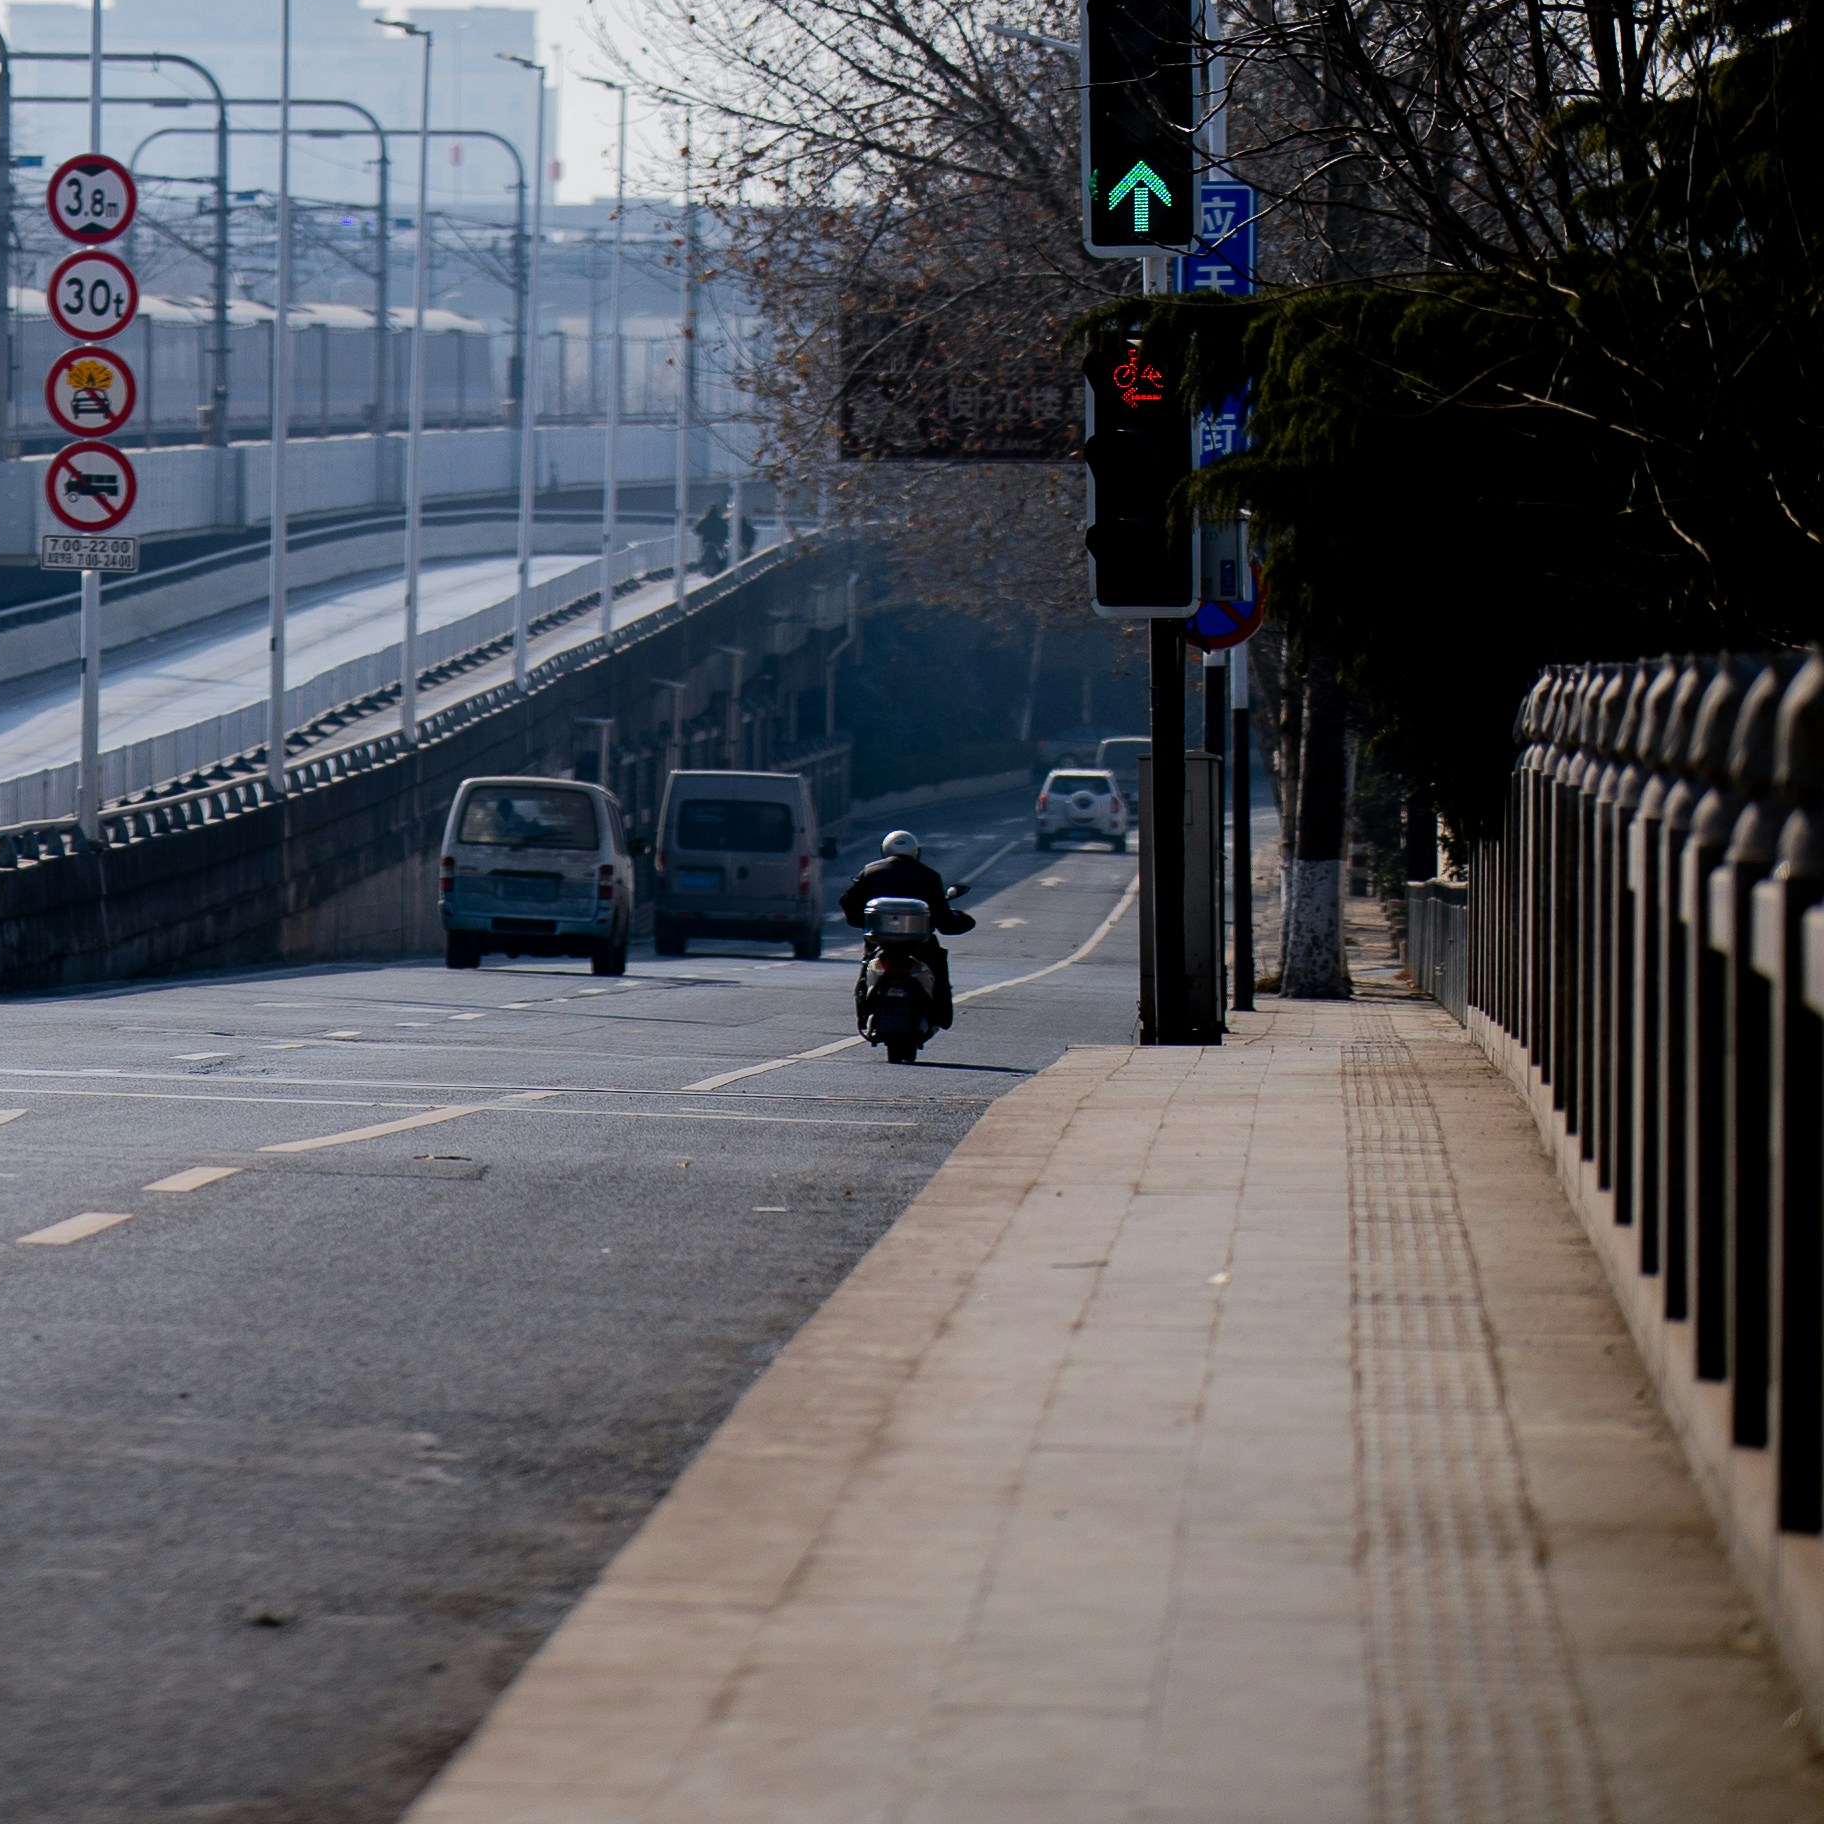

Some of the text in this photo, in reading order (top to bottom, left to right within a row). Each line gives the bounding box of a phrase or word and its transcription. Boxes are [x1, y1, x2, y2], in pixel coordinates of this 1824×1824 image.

[64, 177, 120, 217] 3.8m
[63, 276, 125, 319] 30t
[1194, 195, 1237, 456] 应天街
